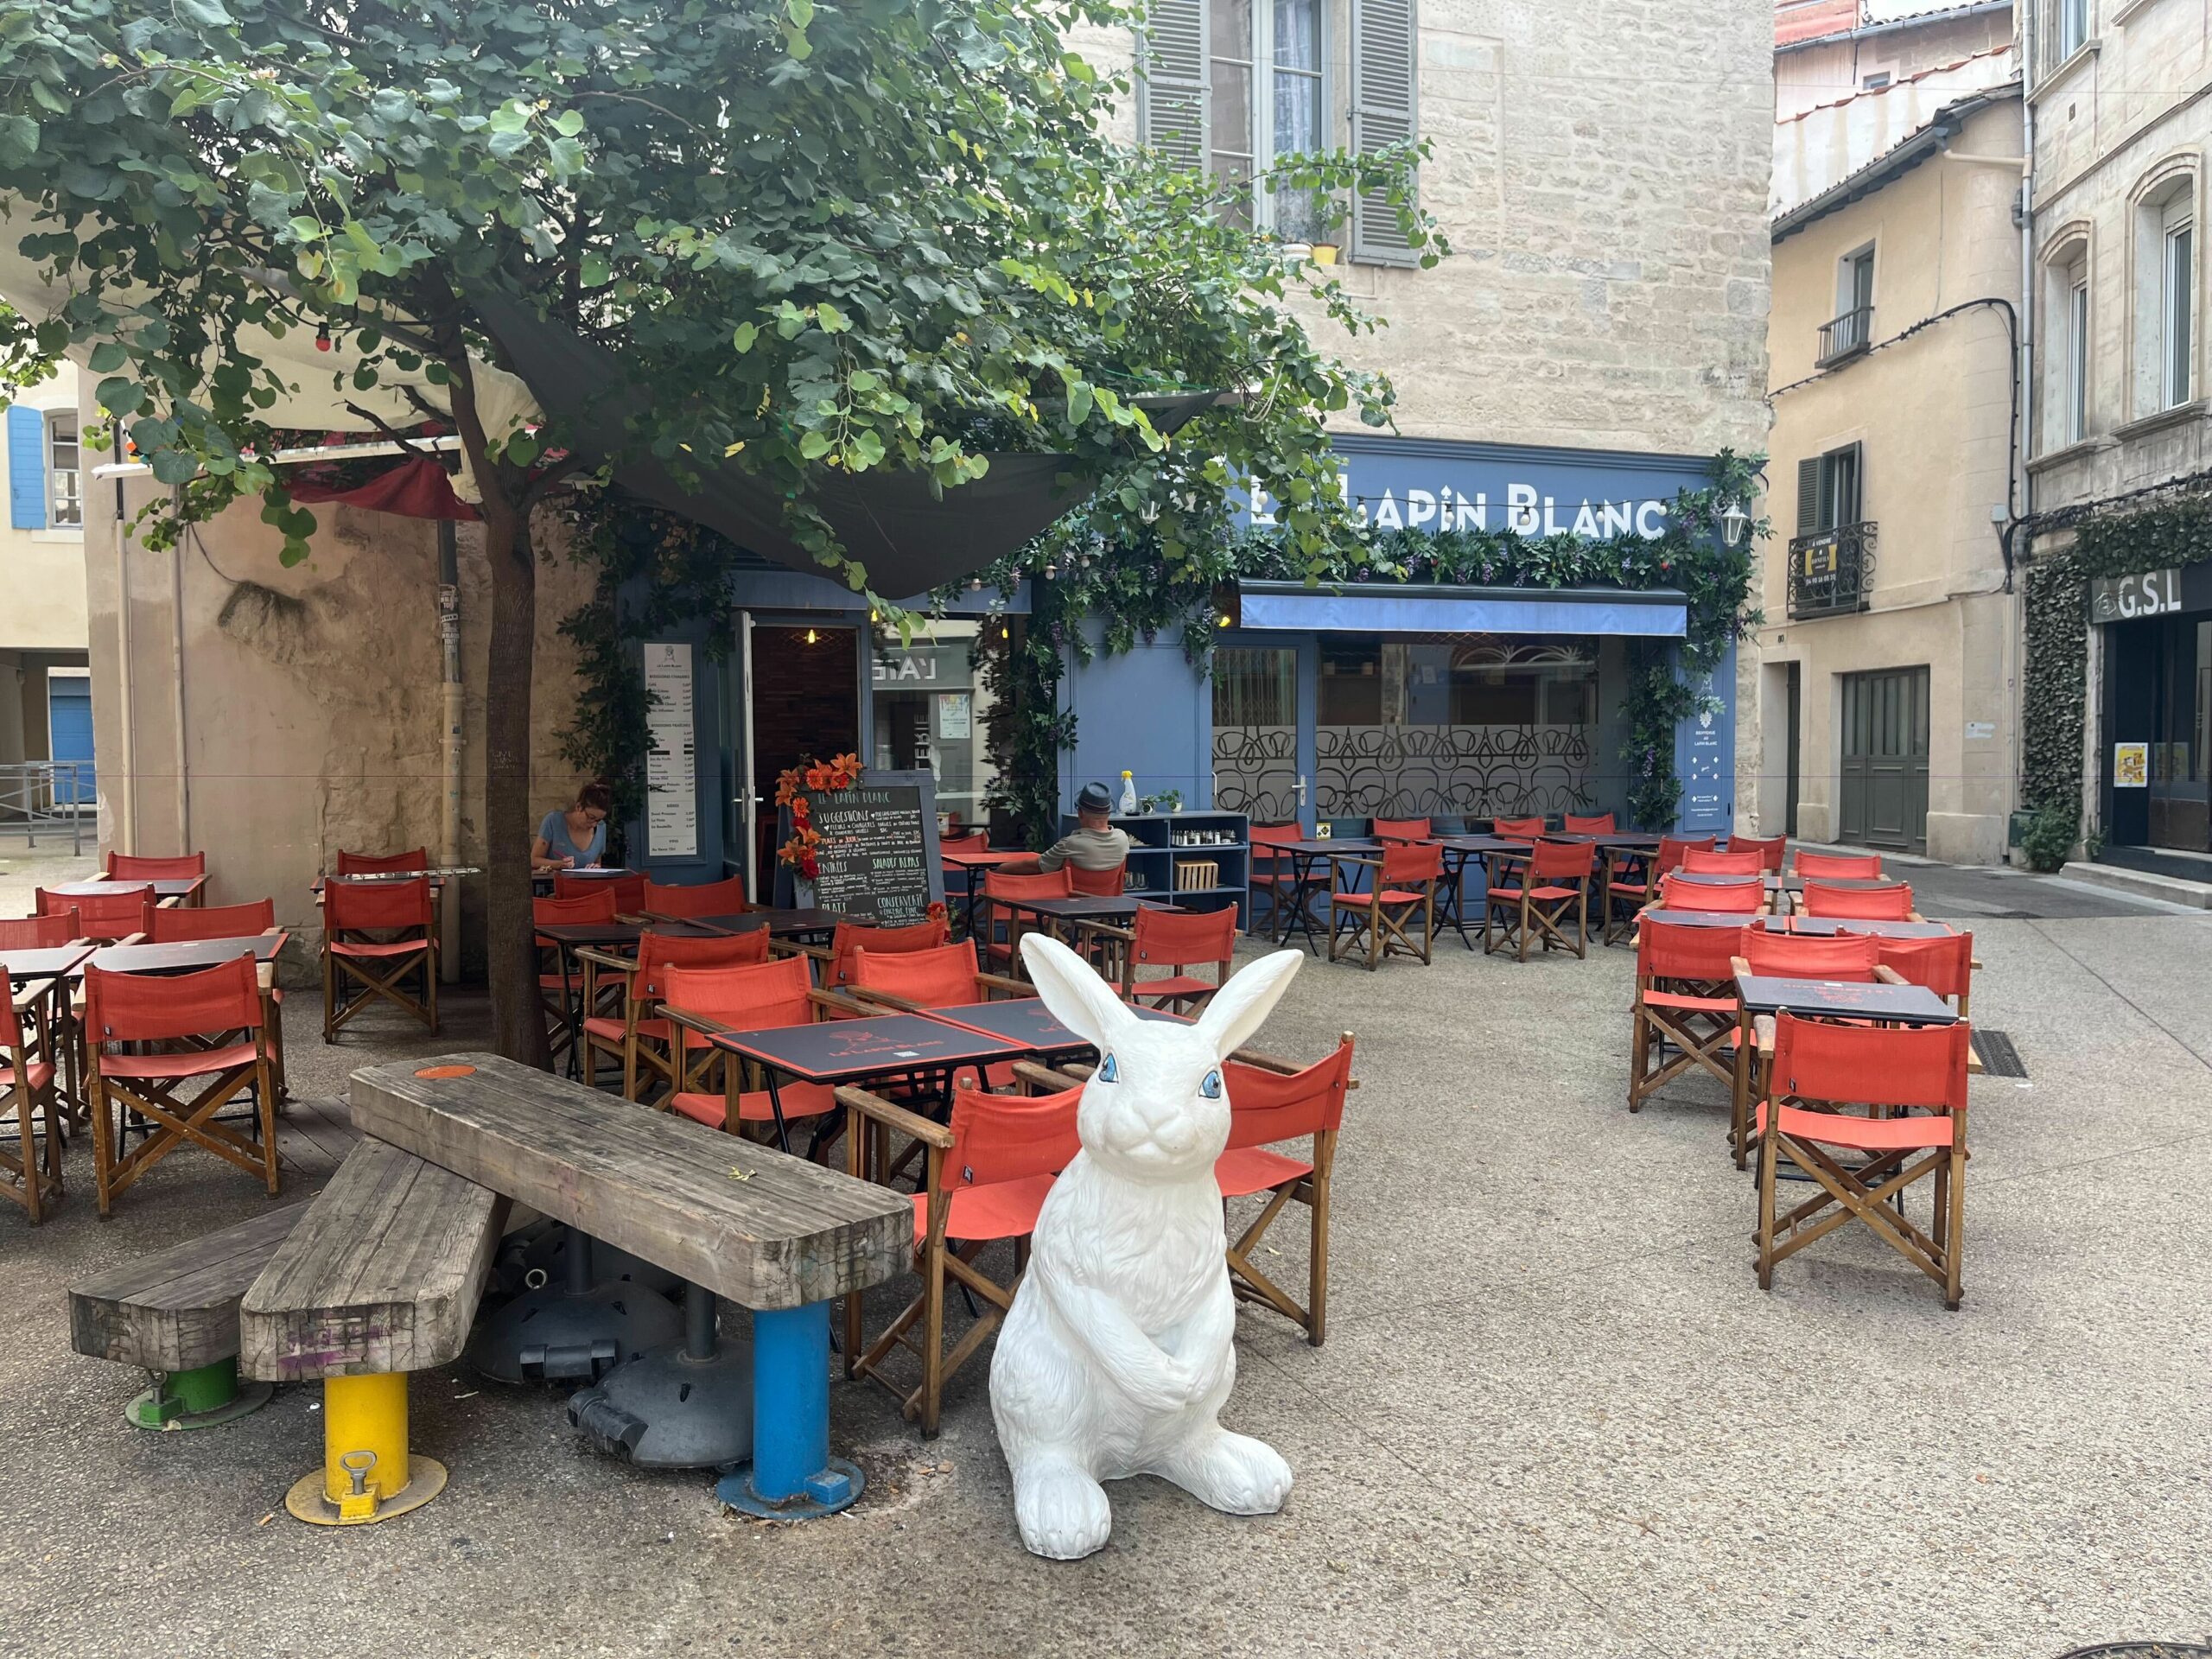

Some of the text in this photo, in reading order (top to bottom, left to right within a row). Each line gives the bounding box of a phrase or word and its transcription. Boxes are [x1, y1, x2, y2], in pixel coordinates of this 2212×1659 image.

[1508, 483, 1666, 540] BLANC
[819, 810, 868, 823] SUGGESTIONS
[872, 856, 919, 869] SALADES REPAS
